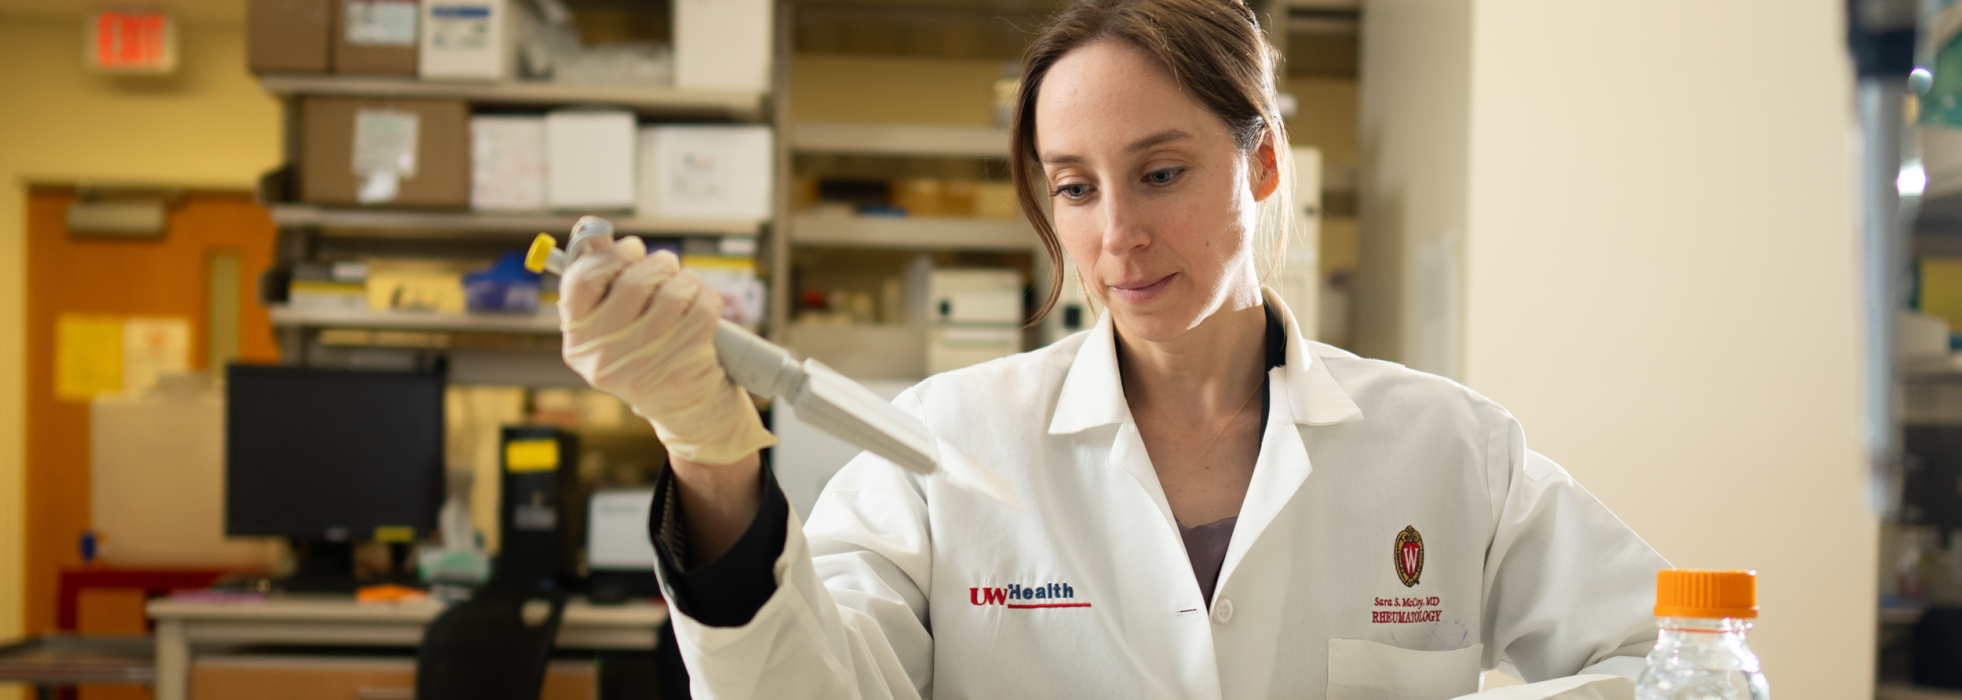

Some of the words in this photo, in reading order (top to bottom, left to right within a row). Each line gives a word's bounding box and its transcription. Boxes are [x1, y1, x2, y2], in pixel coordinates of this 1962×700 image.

[1403, 546, 1419, 574] W
[1374, 596, 1393, 607] Sara
[1394, 597, 1401, 607] S.
[1426, 596, 1440, 607] MD
[1372, 610, 1443, 624] RHEUMATOLOGY
